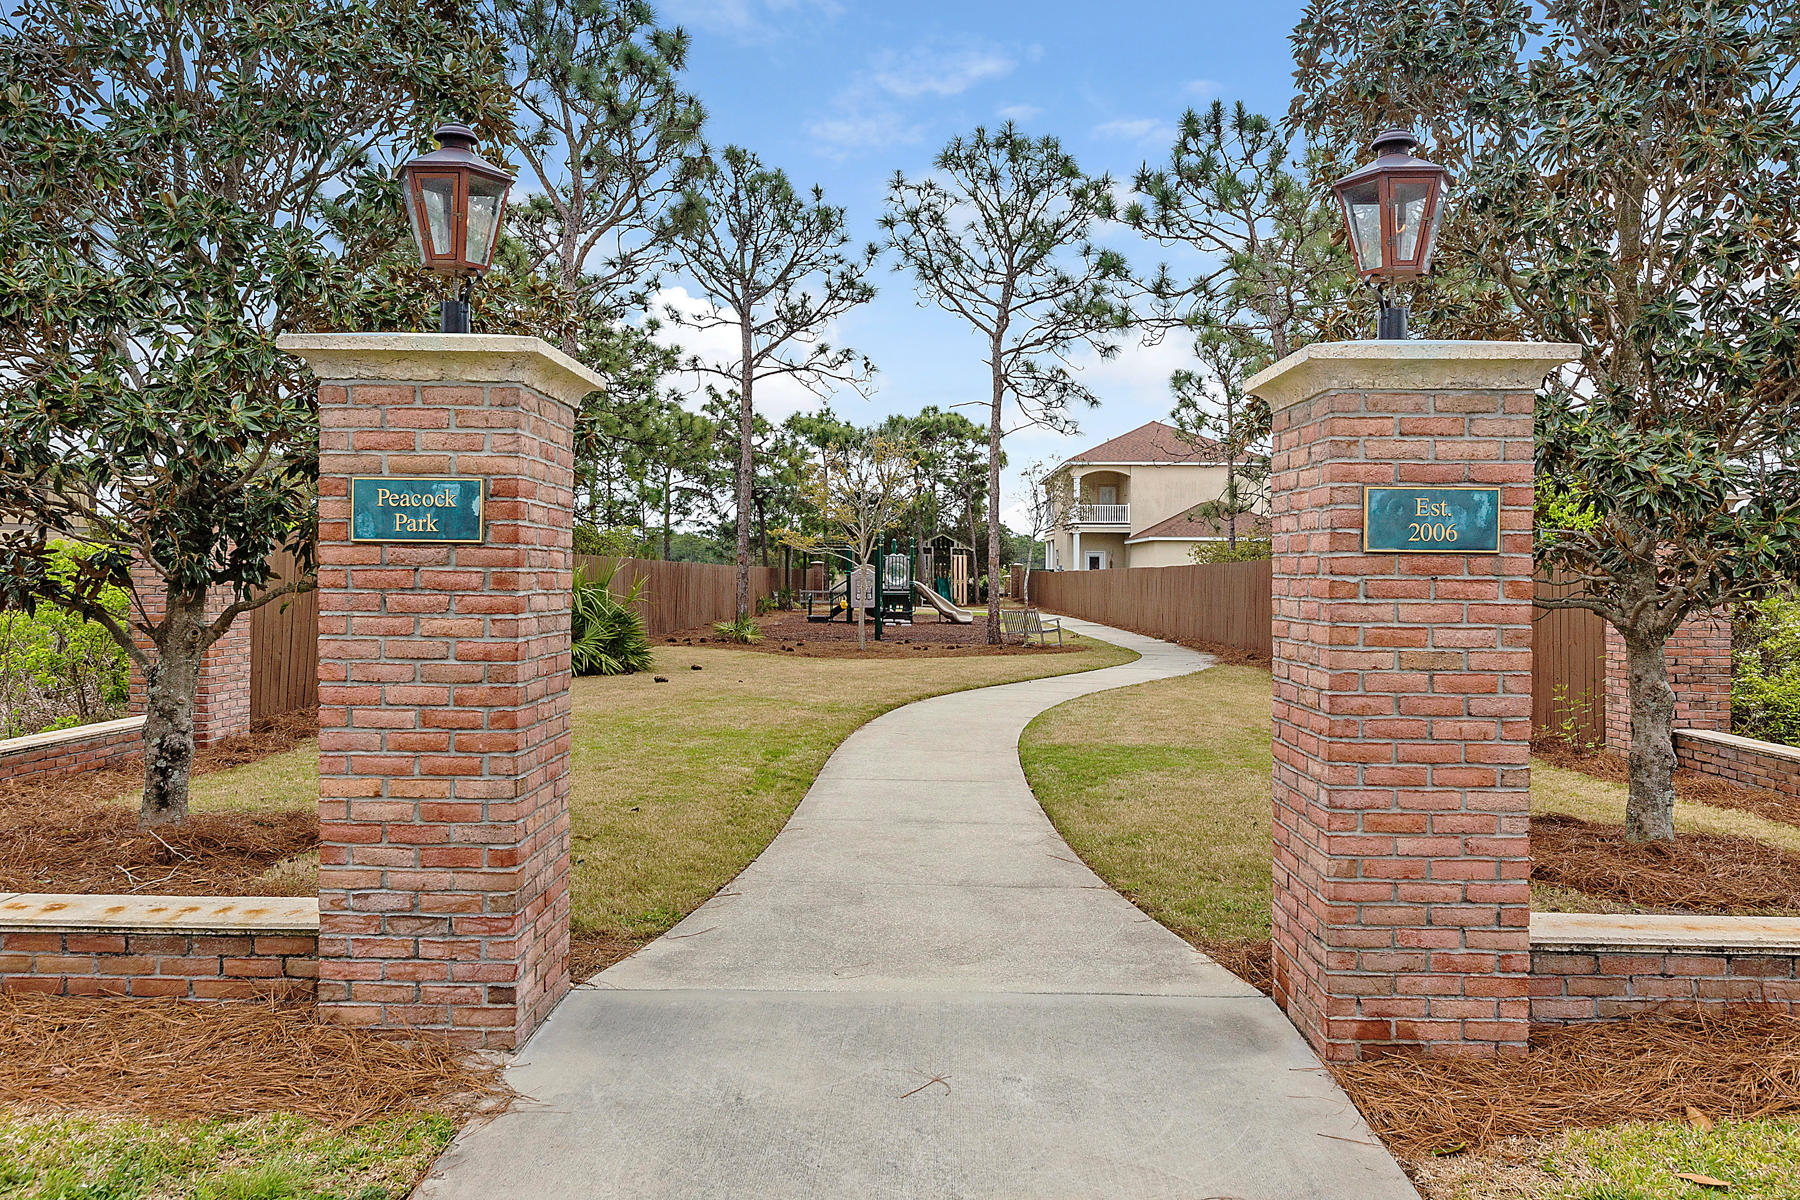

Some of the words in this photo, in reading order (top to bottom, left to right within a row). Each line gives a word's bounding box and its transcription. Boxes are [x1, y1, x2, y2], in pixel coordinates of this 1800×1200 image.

[376, 488, 457, 507] Peacock
[1415, 497, 1452, 517] Est.
[394, 513, 440, 532] Park
[1408, 522, 1458, 542] 2006
